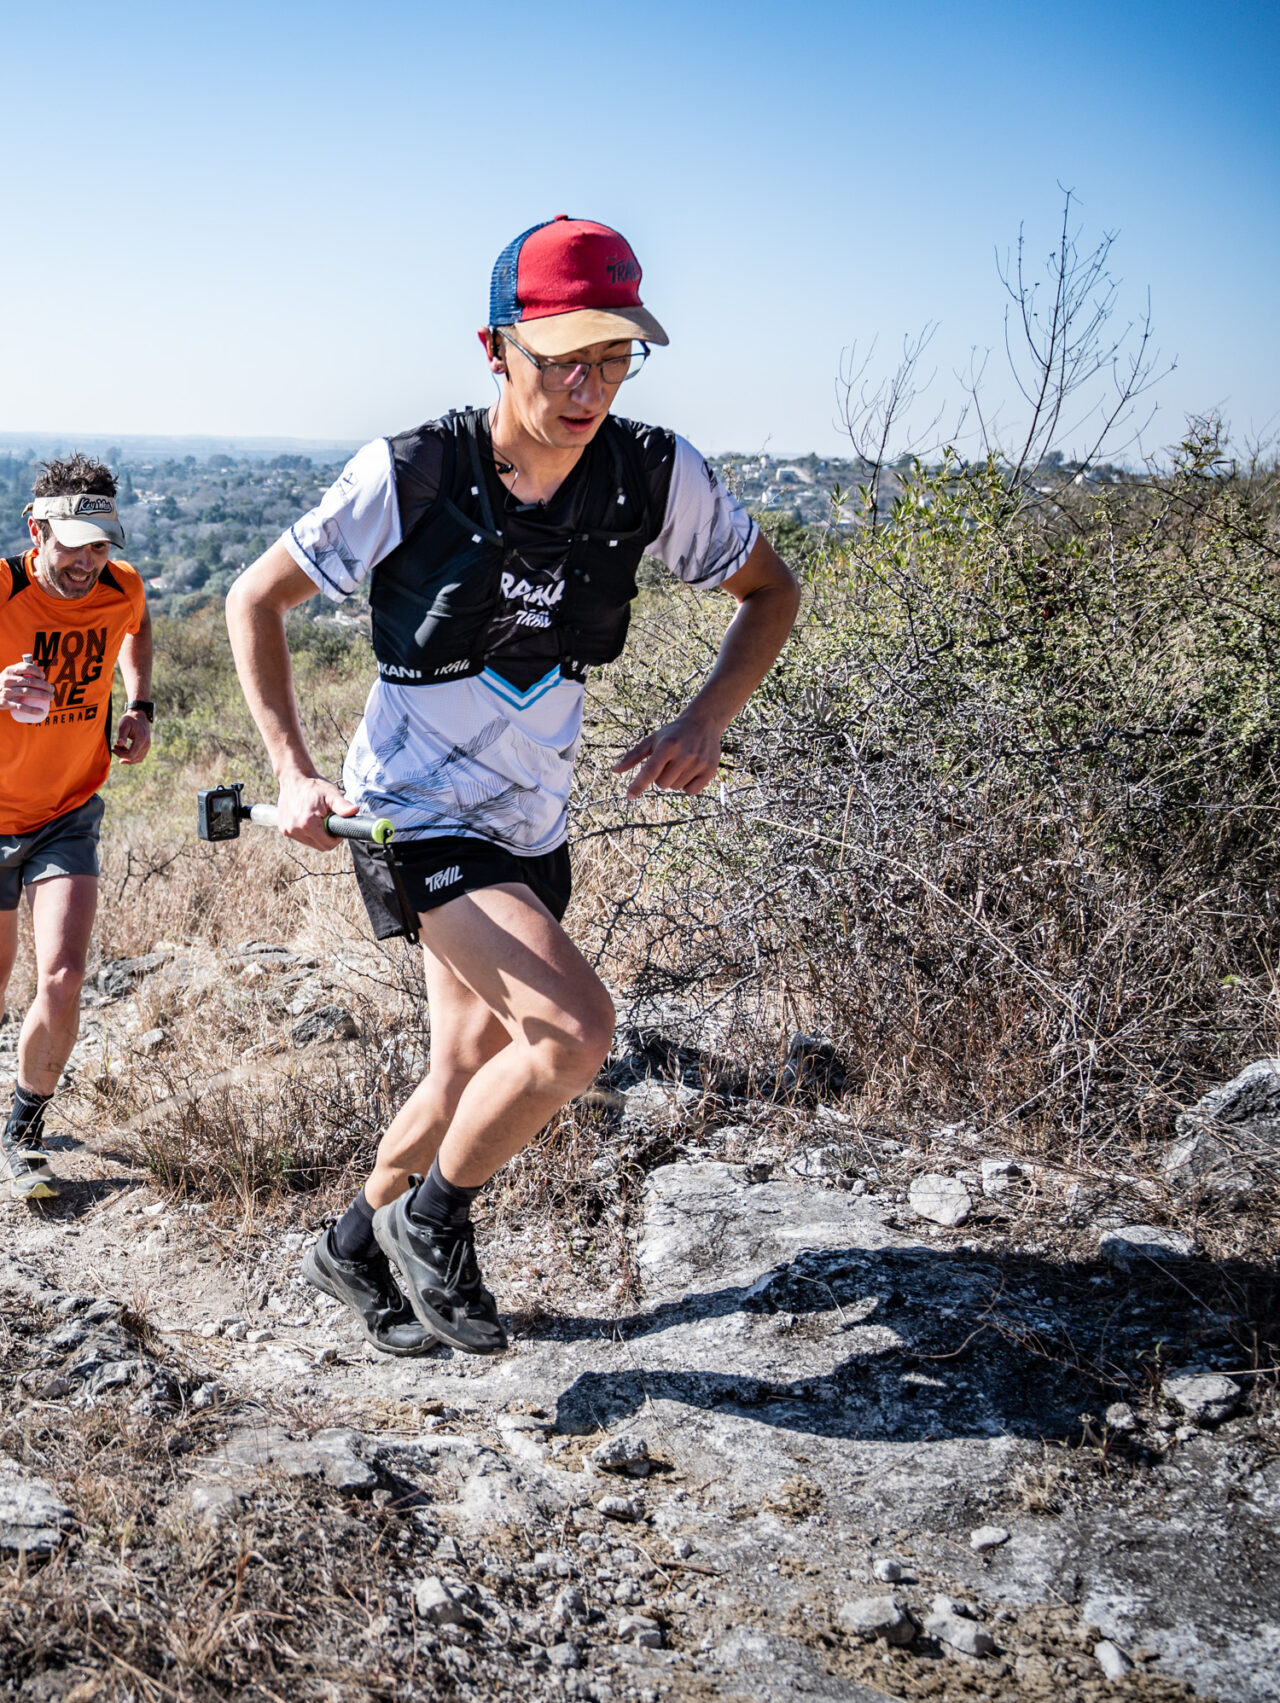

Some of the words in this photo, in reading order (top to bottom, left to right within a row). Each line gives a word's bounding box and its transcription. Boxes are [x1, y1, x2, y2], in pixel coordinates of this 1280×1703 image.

[33, 628, 107, 661] MON
[27, 711, 84, 727] RRERA
[425, 865, 464, 893] TRAIL
